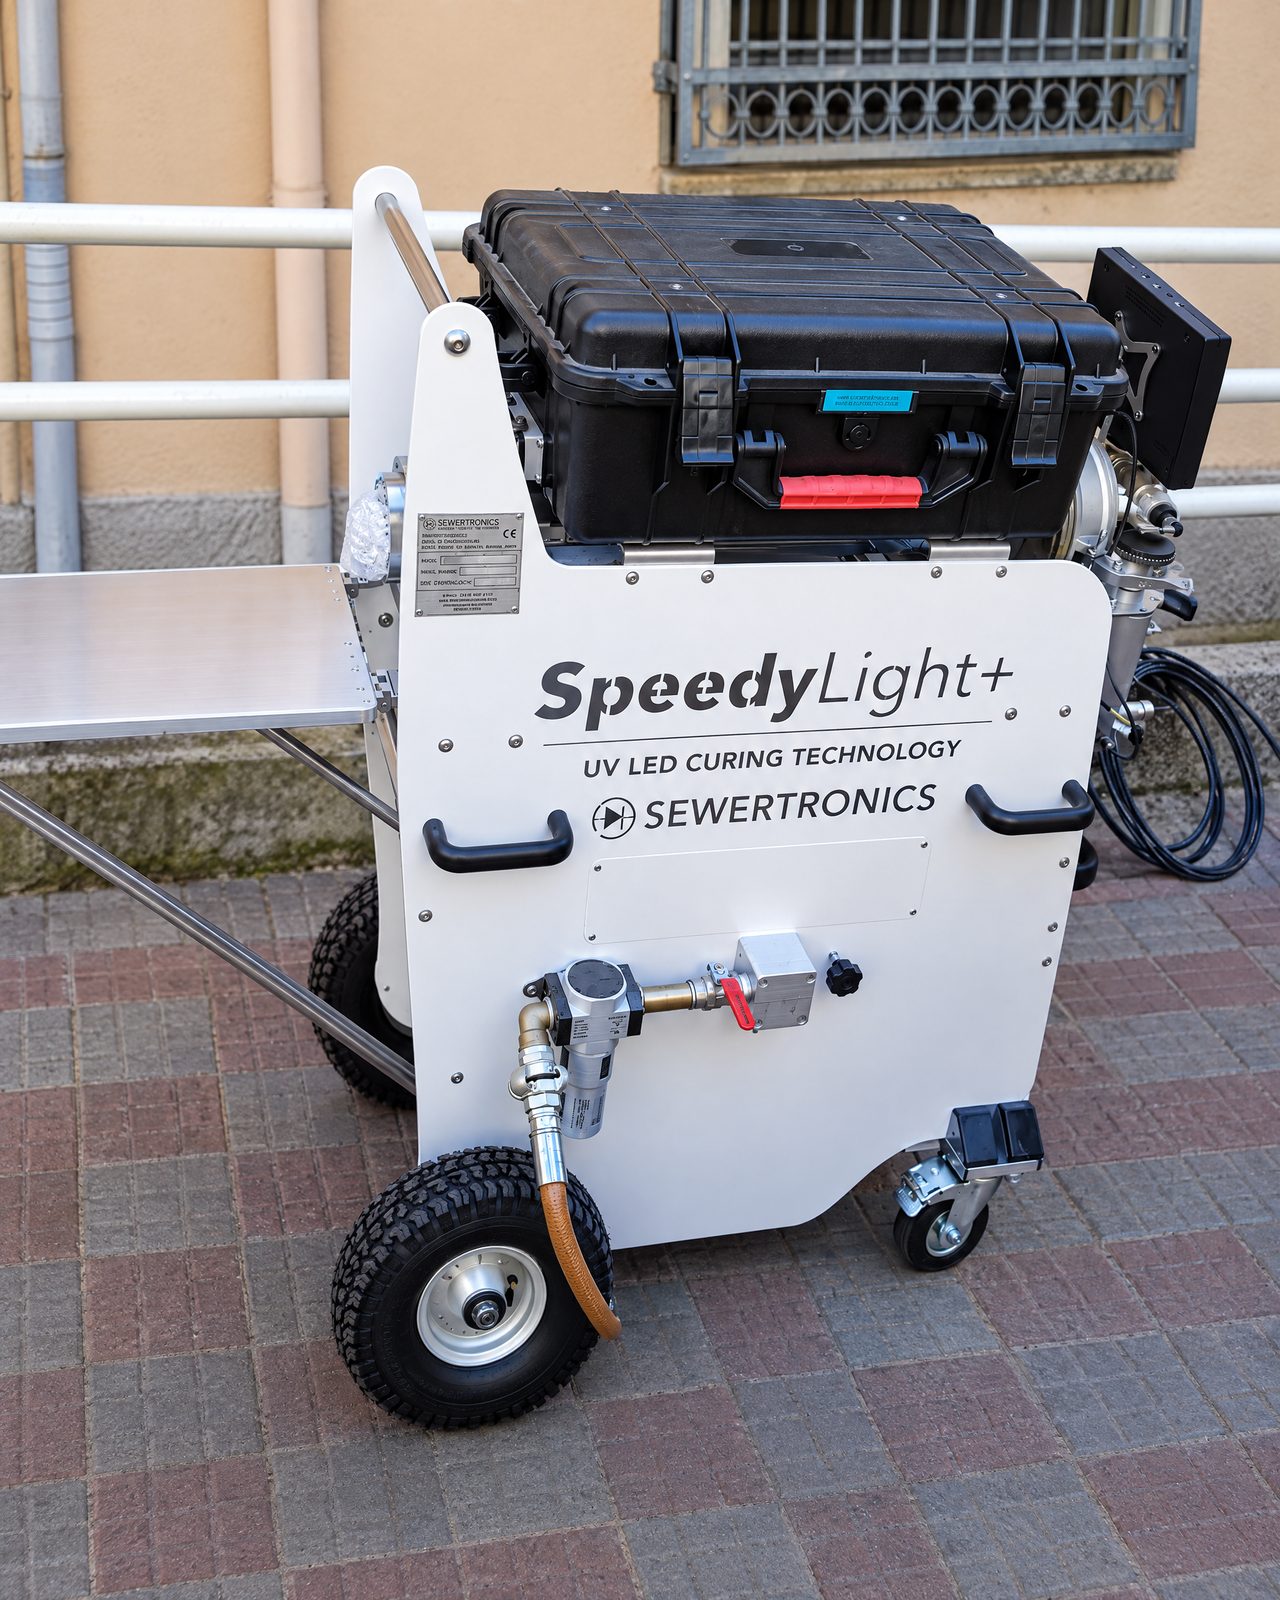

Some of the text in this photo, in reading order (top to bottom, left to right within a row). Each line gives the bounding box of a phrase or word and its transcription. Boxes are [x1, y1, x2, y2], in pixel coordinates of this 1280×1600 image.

[438, 518, 499, 526] SEWERTRONICS
[534, 646, 1014, 732] SpeedyLight+
[584, 739, 962, 779] UV LED CURING TECHNOLOGY
[644, 783, 937, 830] SEWERTRONICS
